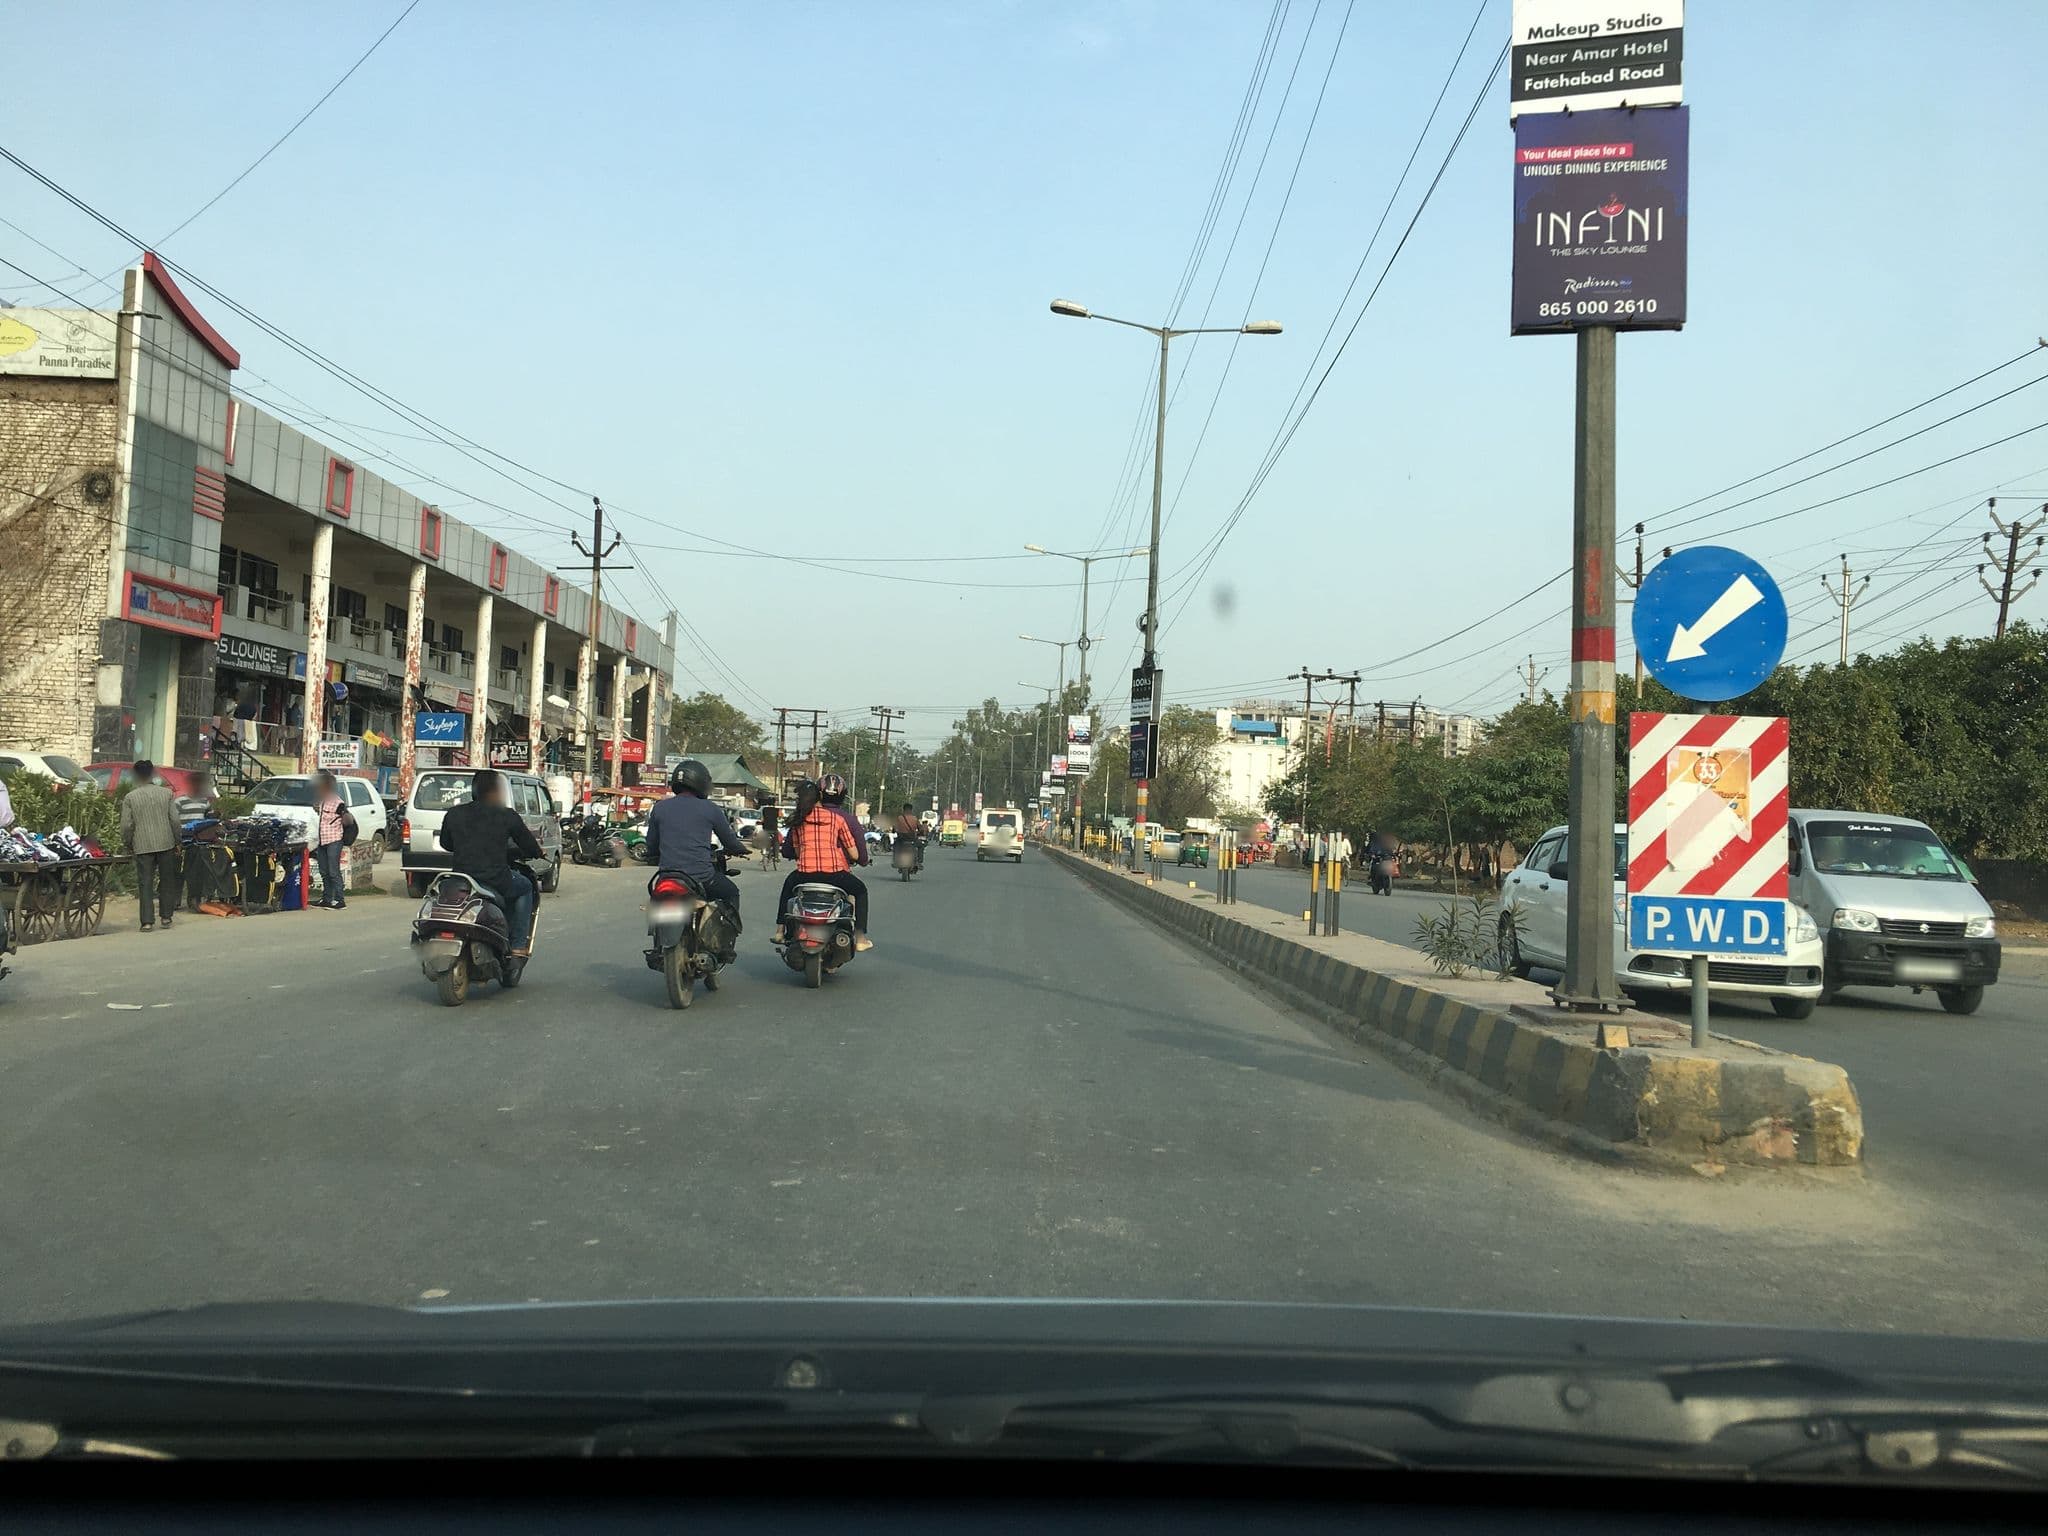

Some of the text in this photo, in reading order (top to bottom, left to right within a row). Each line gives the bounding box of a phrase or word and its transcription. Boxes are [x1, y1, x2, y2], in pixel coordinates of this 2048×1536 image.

[1527, 13, 1663, 40] Makeup Studio
[1525, 38, 1669, 67] Near Amar Hotel
[1524, 63, 1665, 92] Fatehabad Road
[1523, 150, 1545, 160] Your
[1573, 147, 1600, 159] place
[1602, 146, 1617, 156] for
[1619, 146, 1626, 155] a
[1523, 159, 1668, 177] UNIQUE DINING EXPERIENCE
[1550, 245, 1649, 256] THE SKY LOUNGE
[1539, 299, 1658, 316] 865 000 2610
[65, 344, 86, 354] Hotel
[39, 355, 112, 370] Panna Paradise
[231, 640, 278, 663] LOUNGE
[509, 745, 529, 755] TAJ
